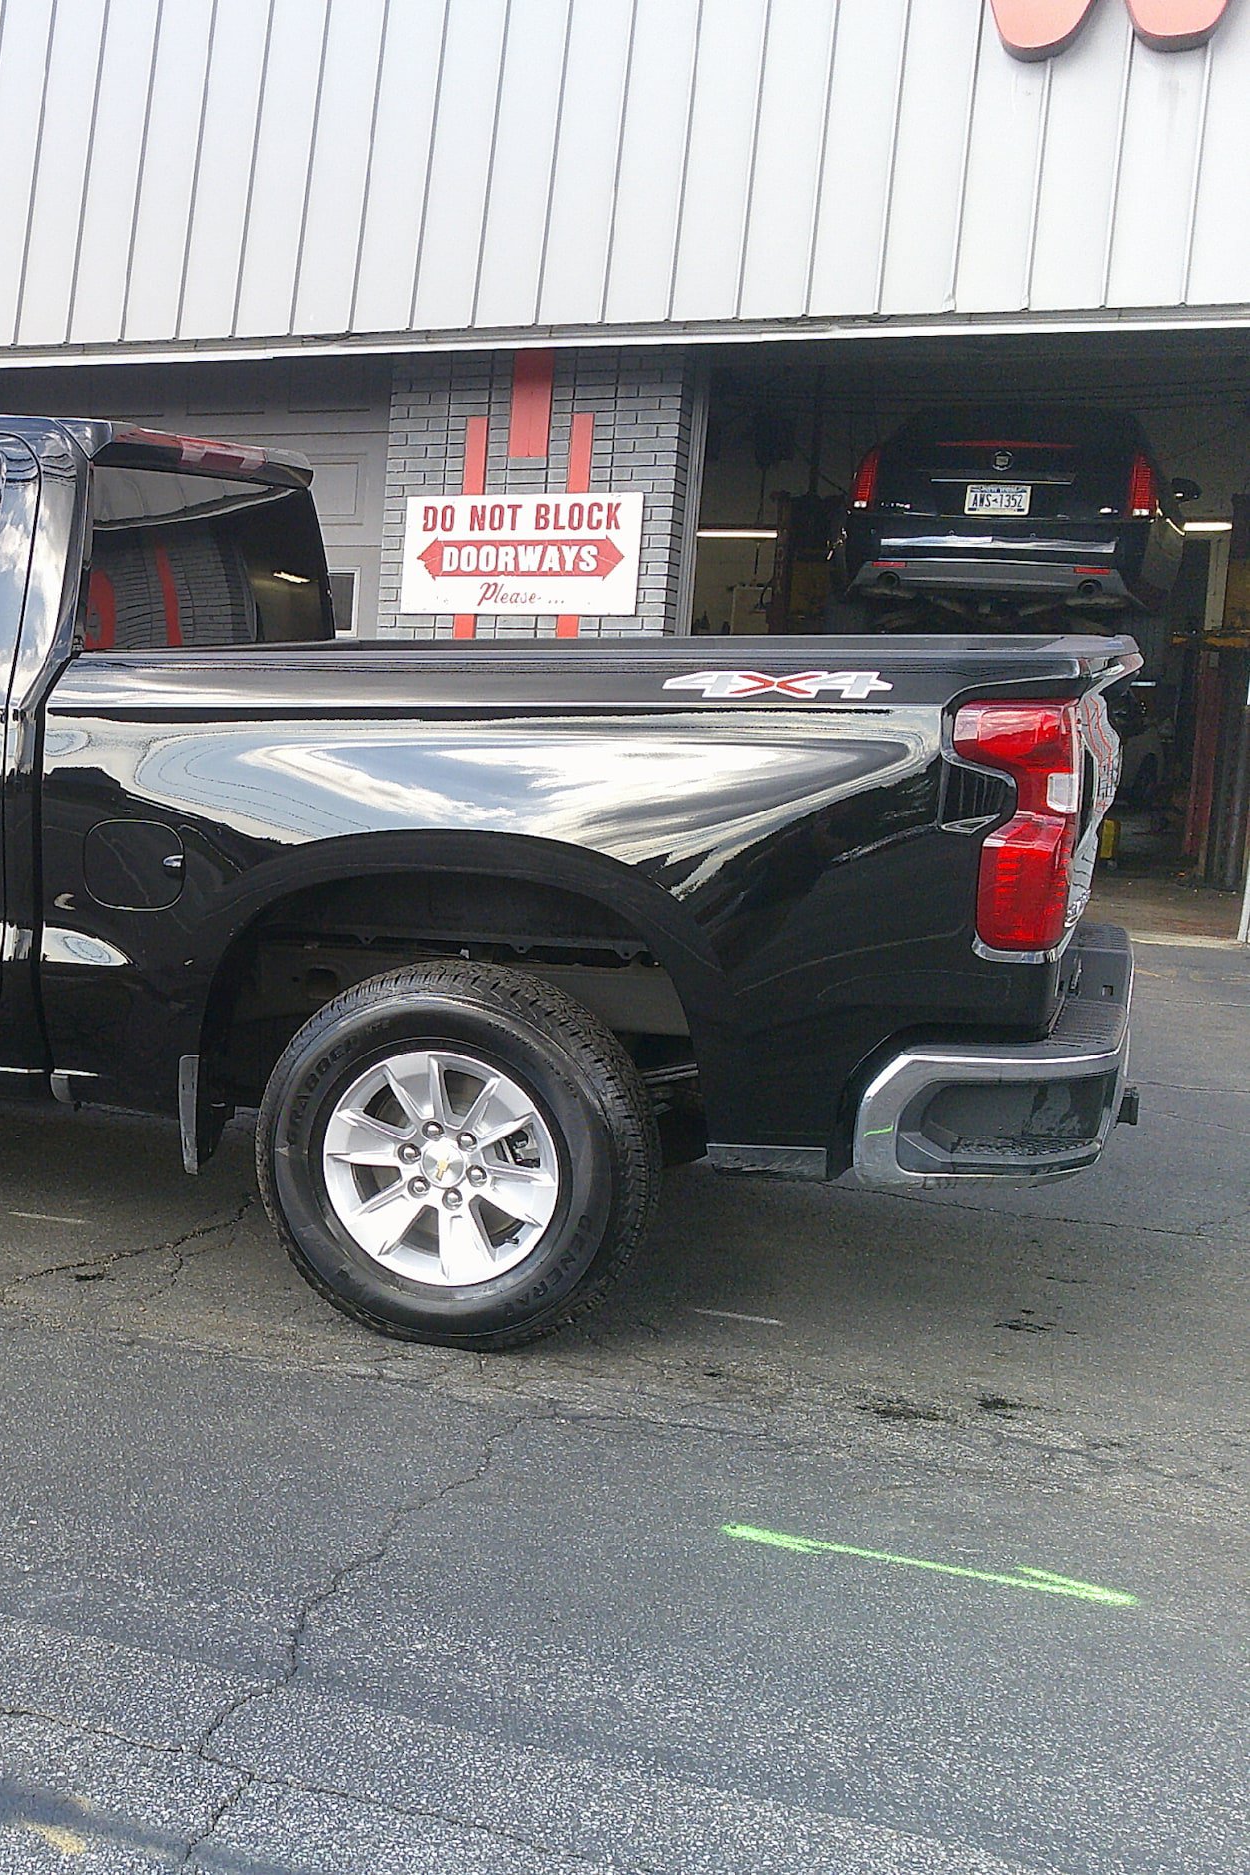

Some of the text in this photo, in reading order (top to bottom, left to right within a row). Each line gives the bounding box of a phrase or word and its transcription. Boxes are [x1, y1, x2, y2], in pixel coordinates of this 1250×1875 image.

[422, 502, 622, 532] DO NOT BLOCK
[441, 544, 600, 574] DOORWAYS
